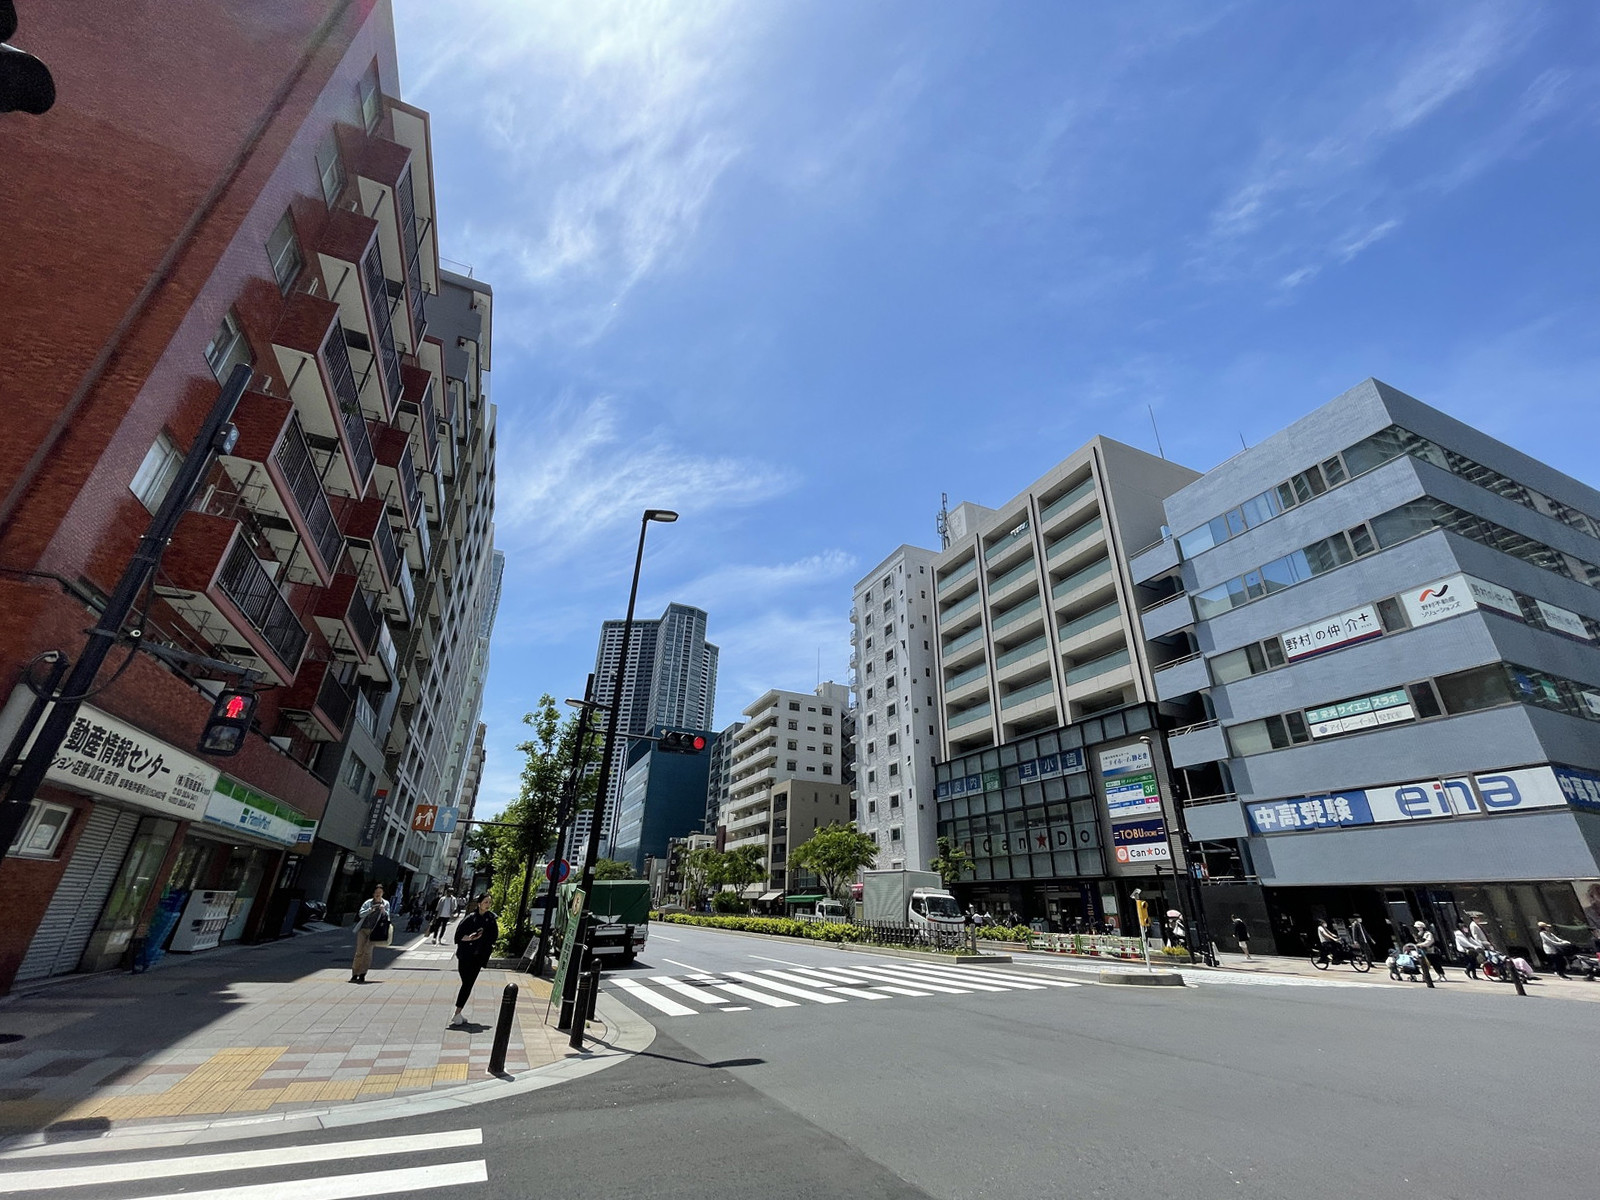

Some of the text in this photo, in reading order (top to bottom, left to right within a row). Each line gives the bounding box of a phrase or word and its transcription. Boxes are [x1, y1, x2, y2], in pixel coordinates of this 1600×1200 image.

[1421, 596, 1456, 611] 野村不動産
[1421, 601, 1461, 618] ソリューションズ
[63, 716, 171, 779] 動産情報センター
[1023, 752, 1077, 775] 耳 小 歯
[1144, 784, 1155, 793] 3F
[1394, 775, 1521, 816] ena
[1557, 774, 1600, 802] 中高受
[1253, 796, 1354, 829] 中高受験
[1119, 828, 1144, 840] TOBU
